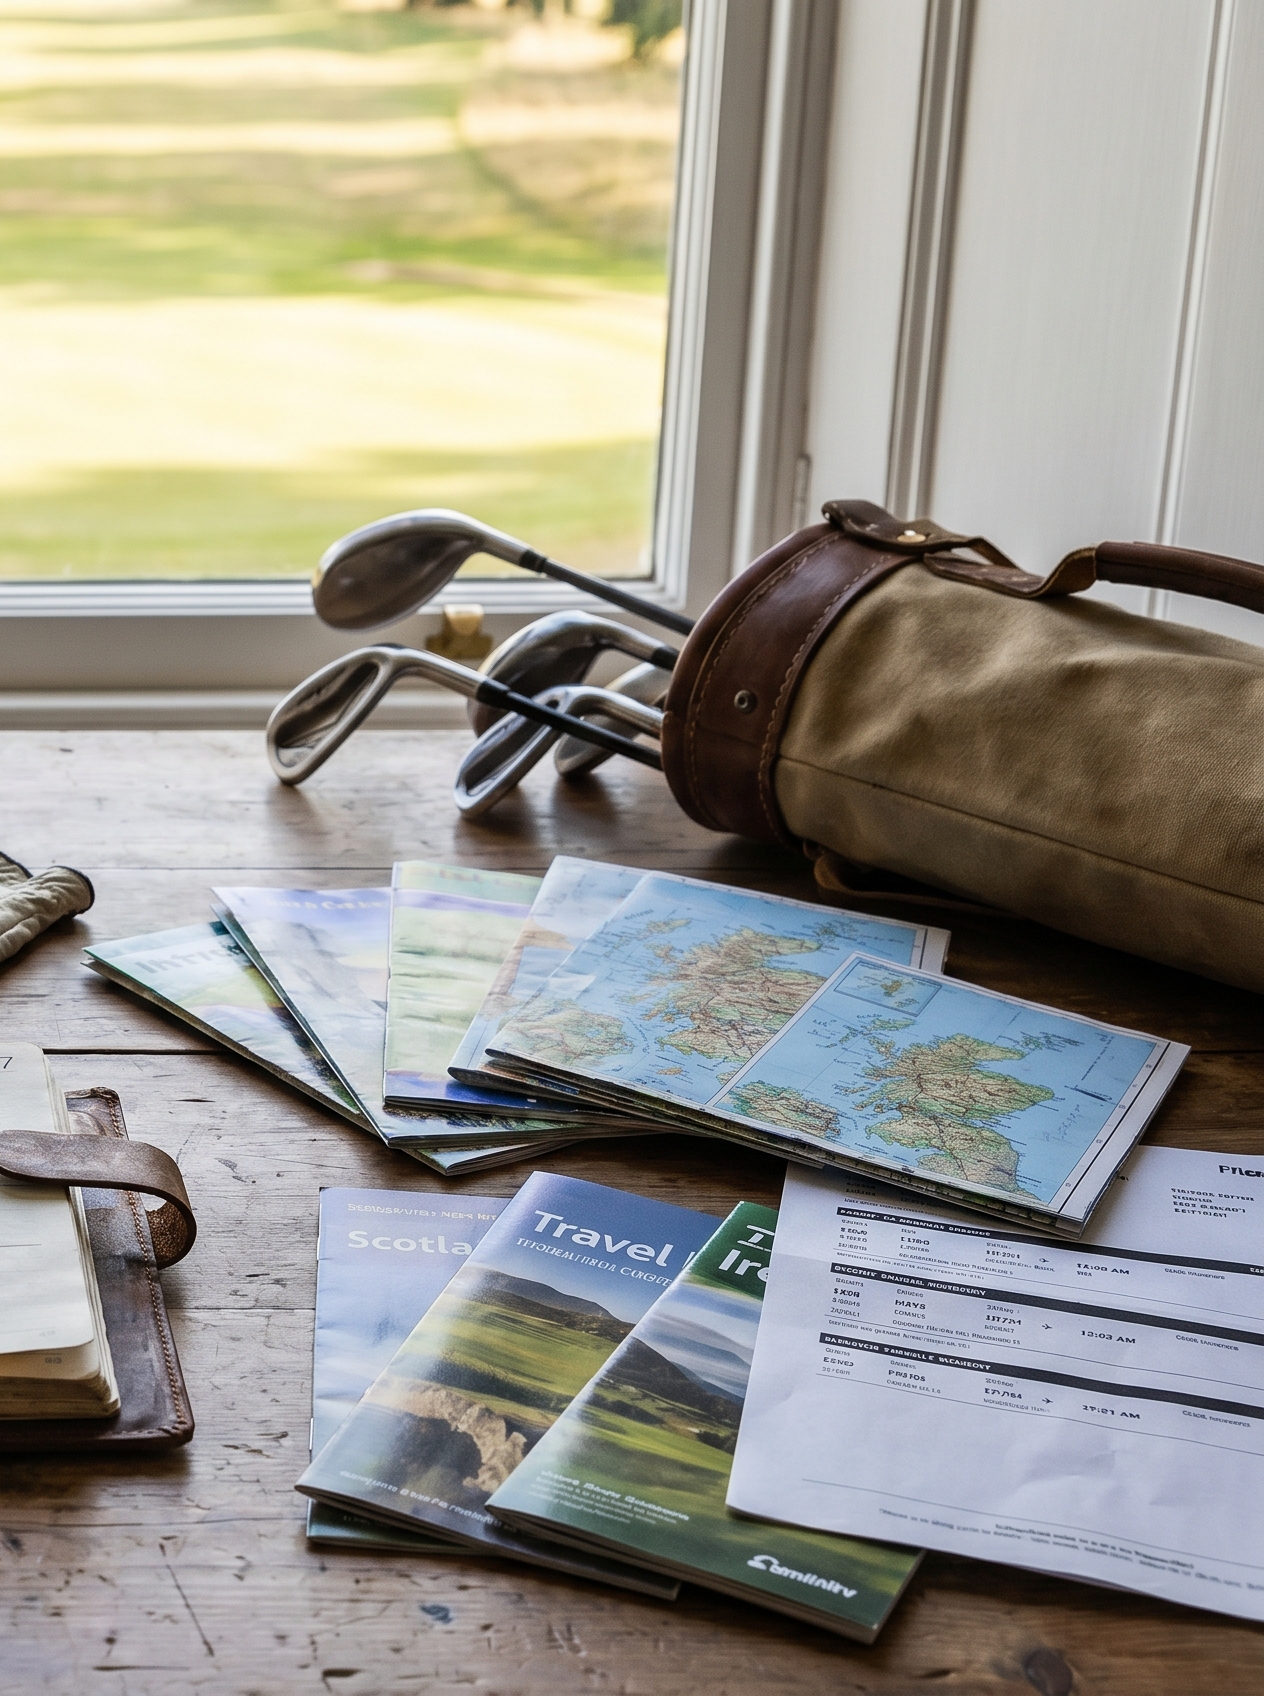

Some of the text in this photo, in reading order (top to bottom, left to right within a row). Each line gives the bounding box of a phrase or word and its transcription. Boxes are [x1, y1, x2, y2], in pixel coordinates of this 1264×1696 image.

[533, 1209, 675, 1267] Travel
[347, 1230, 473, 1256] Scotla
[1111, 1267, 1130, 1275] AM
[1116, 1335, 1136, 1344] AM
[1120, 1411, 1141, 1420] AM
